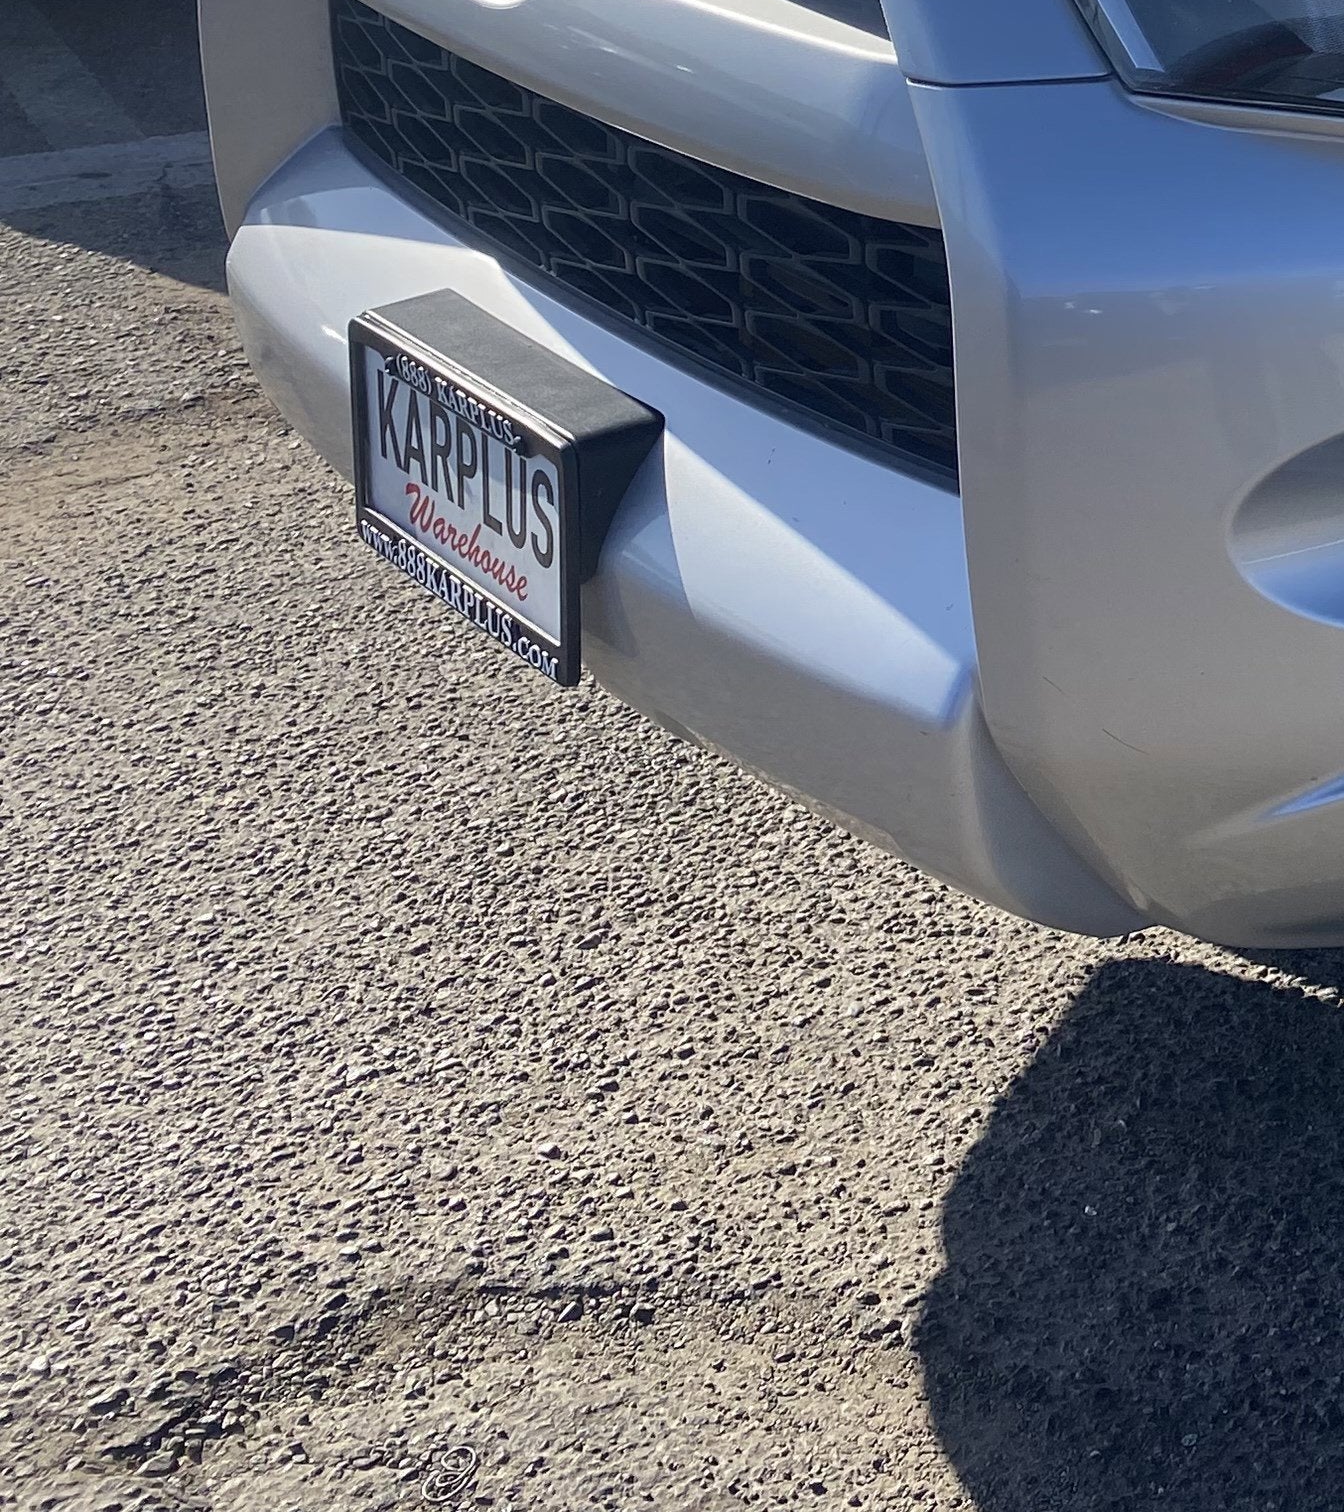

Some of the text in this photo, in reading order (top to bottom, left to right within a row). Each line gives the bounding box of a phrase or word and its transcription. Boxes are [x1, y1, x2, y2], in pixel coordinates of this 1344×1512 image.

[396, 354, 515, 445] (888) KARPLUS
[377, 369, 555, 569] KARPLUS
[405, 482, 528, 601] Warehouse
